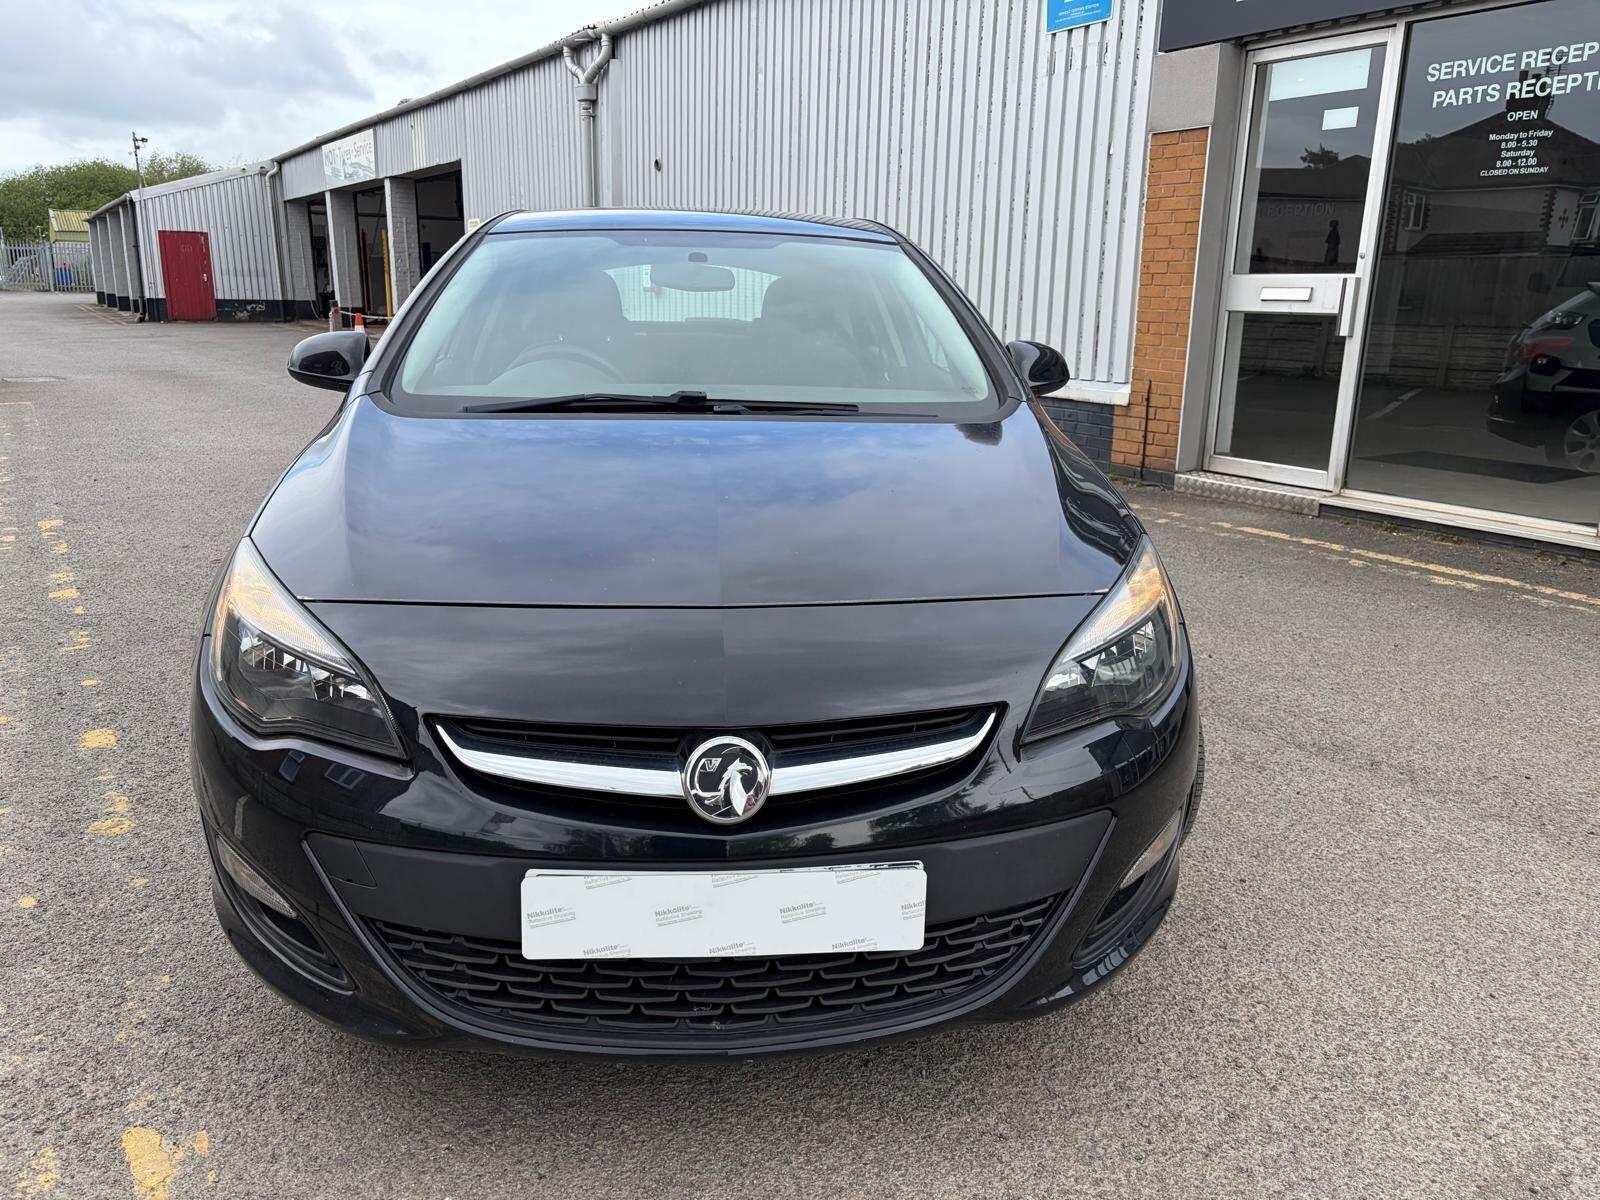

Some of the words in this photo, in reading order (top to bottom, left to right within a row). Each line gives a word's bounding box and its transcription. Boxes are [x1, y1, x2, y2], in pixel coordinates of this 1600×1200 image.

[1426, 53, 1516, 82] SERVICE
[1432, 83, 1500, 108] PARTS
[1507, 109, 1539, 122] OPEN
[1489, 132, 1519, 141] Monday
[1520, 131, 1527, 139] to
[1528, 130, 1553, 138] Friday
[1500, 141, 1517, 149] 8.00
[1522, 139, 1538, 147] 5.30
[1500, 149, 1536, 158] Saturday
[1495, 160, 1512, 168] 8.00
[1518, 157, 1537, 166] 12.00
[1480, 169, 1508, 177] CLOSED
[1520, 166, 1549, 174] SUNDAY
[527, 907, 563, 920] Nikkolite
[654, 904, 690, 918] Nikkolite
[779, 901, 814, 915] Nikkolite
[583, 944, 618, 957] Nikkolite
[709, 941, 744, 955] Nikkolite
[832, 938, 866, 950] Nikkolite
